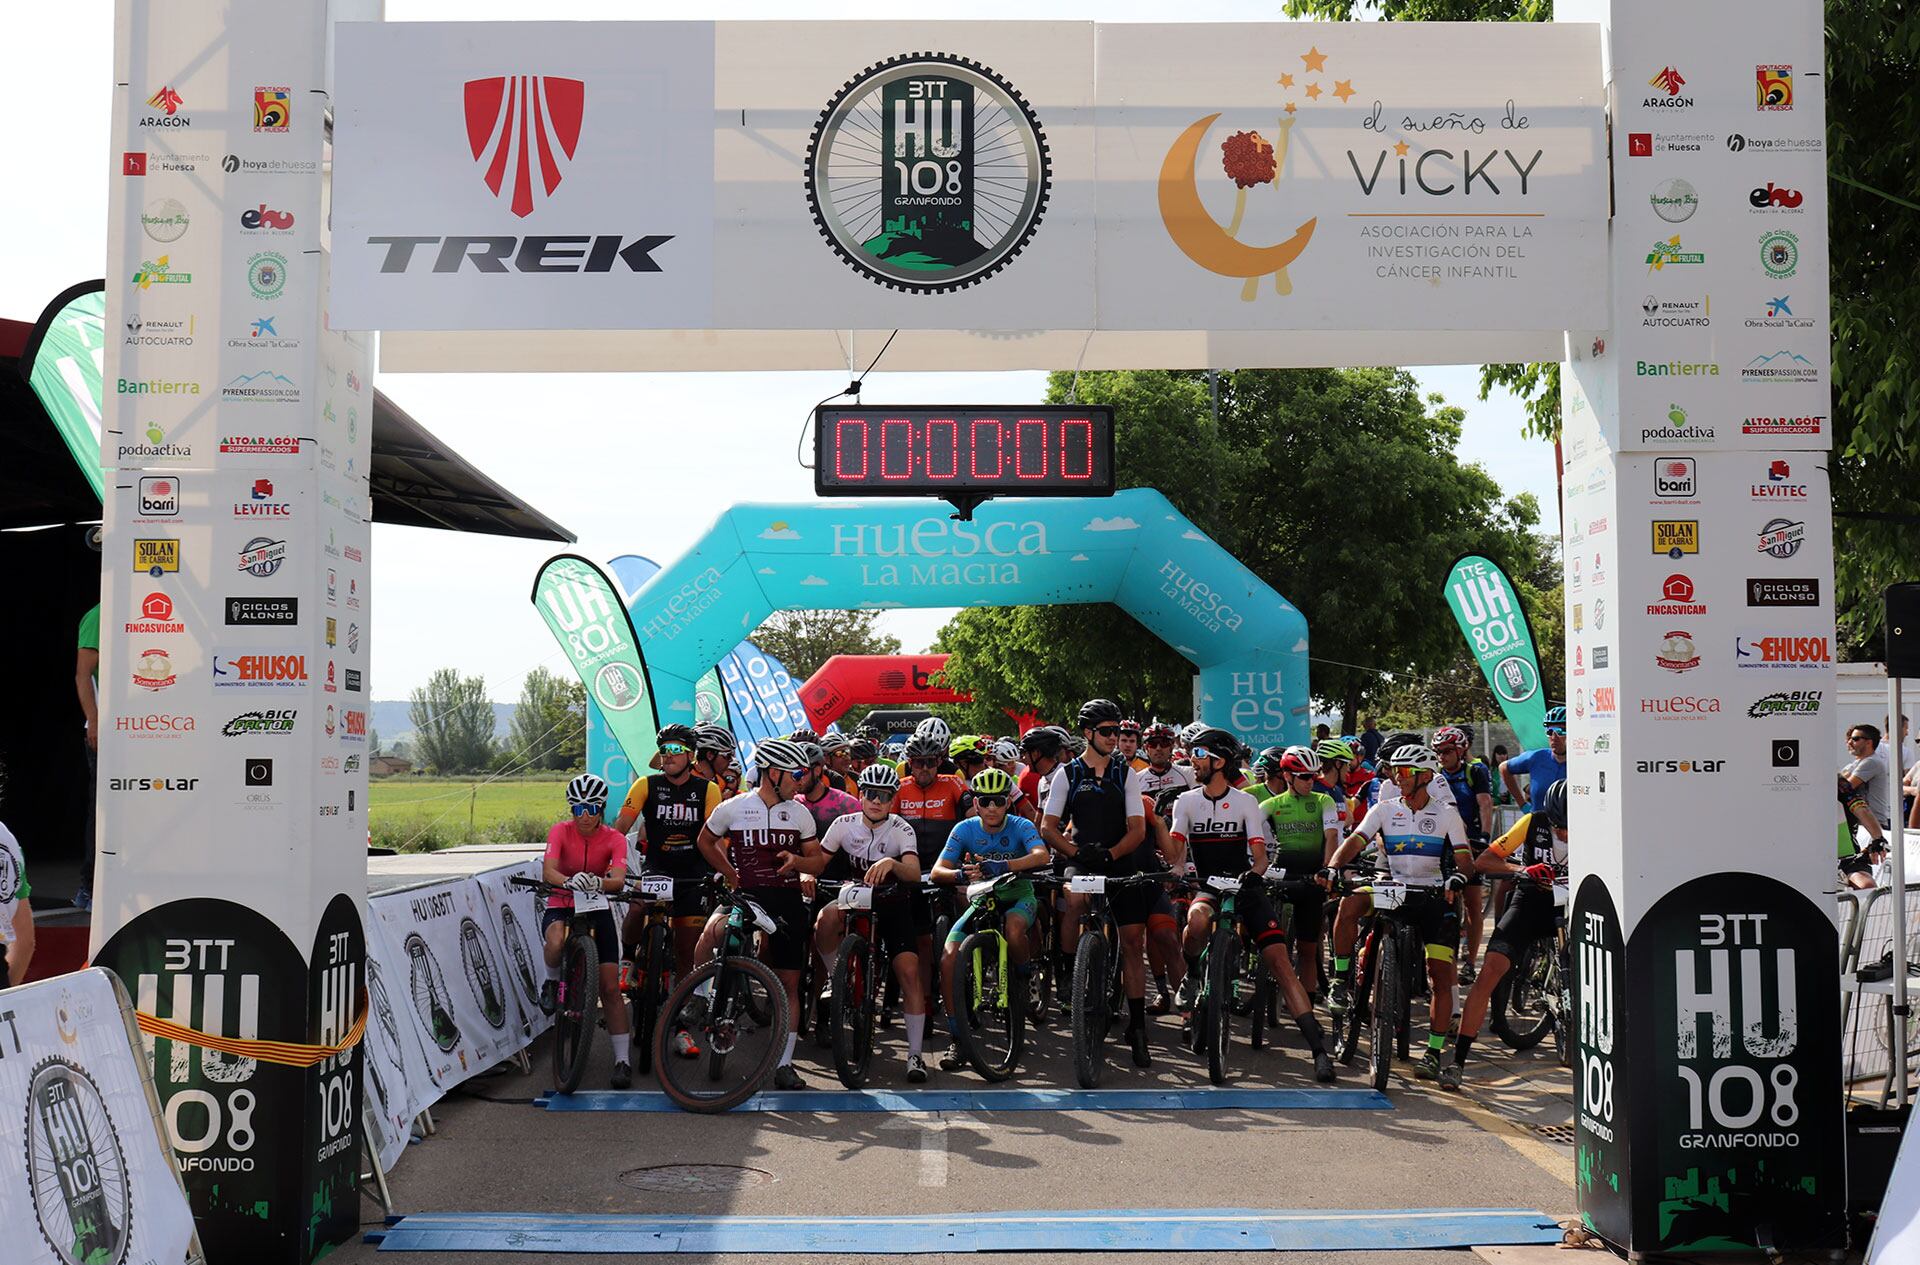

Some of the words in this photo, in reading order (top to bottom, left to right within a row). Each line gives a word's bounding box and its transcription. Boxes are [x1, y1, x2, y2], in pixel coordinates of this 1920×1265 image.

[1642, 96, 1694, 107] ARAGÓN
[139, 115, 190, 127] ARAGÓN
[1363, 100, 1386, 134] el
[1401, 112, 1486, 135] sueño
[1501, 99, 1530, 131] de
[893, 99, 962, 158] HU
[1655, 133, 1715, 143] Ayuntamiento
[1748, 138, 1773, 149] hoya
[1668, 143, 1701, 151] Huesca
[150, 153, 210, 163] Ayuntamiento
[162, 163, 195, 172] Huesca
[242, 159, 267, 171] hoya
[894, 160, 962, 196] 108
[894, 196, 962, 206] GRANFONDO
[1360, 223, 1460, 239] ASOCIACIÓN
[1465, 226, 1508, 239] PARA
[1512, 226, 1533, 239] LA
[366, 235, 677, 273] TREK
[1367, 243, 1490, 259] INVESTIGACIÓN
[1496, 246, 1526, 259] DEL
[1376, 262, 1441, 279] CÁNCER
[1447, 266, 1518, 279] INFANTIL
[1642, 318, 1710, 327] AUTOCUATRO
[1745, 320, 1763, 328] Obra
[1764, 320, 1784, 328] Social
[125, 337, 193, 346] AUTOCUATRO
[228, 340, 246, 348] Obra
[248, 340, 268, 348] Social
[1637, 361, 1720, 376] Bantierra
[1742, 368, 1818, 376] PYRENEESPASSION.COM
[117, 379, 200, 394] Bantierra
[222, 388, 300, 397] PYRENEESPASSION.COM
[1742, 415, 1820, 426] ALTOARAGÓN
[220, 435, 299, 446] ALTOARAGÓN
[1642, 426, 1715, 443] podoactiva
[118, 444, 191, 460] podoactiva
[835, 419, 1093, 480] 00:00:00
[1658, 478, 1691, 492] barri
[1751, 485, 1807, 497] LEVITEC
[142, 497, 174, 511] barri
[234, 503, 290, 515] LEVITEC
[1658, 524, 1693, 537] SOLAN
[1658, 537, 1667, 545] DE
[1668, 536, 1693, 545] CABRAS
[139, 543, 174, 556] SOLAN
[139, 555, 147, 564] DE
[148, 555, 174, 564] CABRAS
[1647, 605, 1706, 615] FINCASVICAM
[125, 623, 185, 633] FINCASVICAM
[1763, 637, 1830, 662] EHUSOL
[239, 656, 308, 680] EHUSOL
[1791, 691, 1822, 700] BICI
[814, 694, 840, 717] barri
[1759, 700, 1820, 711] FACTOR
[265, 710, 297, 720] BICI
[233, 719, 294, 731] FACTOR
[887, 719, 918, 730] podoa
[656, 804, 699, 820] PEDAL
[1193, 818, 1238, 833] alen
[647, 881, 668, 893] 730
[852, 890, 859, 900] 7
[1579, 942, 1613, 1055] HU
[1675, 948, 1798, 1059] HU
[1581, 1052, 1613, 1124] 108
[1678, 1064, 1798, 1129] 108
[319, 1070, 353, 1143] 108
[164, 1088, 256, 1152] 08
[317, 1133, 352, 1162] GRANFONDO
[1679, 1133, 1799, 1149] GRANFONDO
[176, 1157, 254, 1172] NFONDO
[62, 1154, 99, 1197] 108
